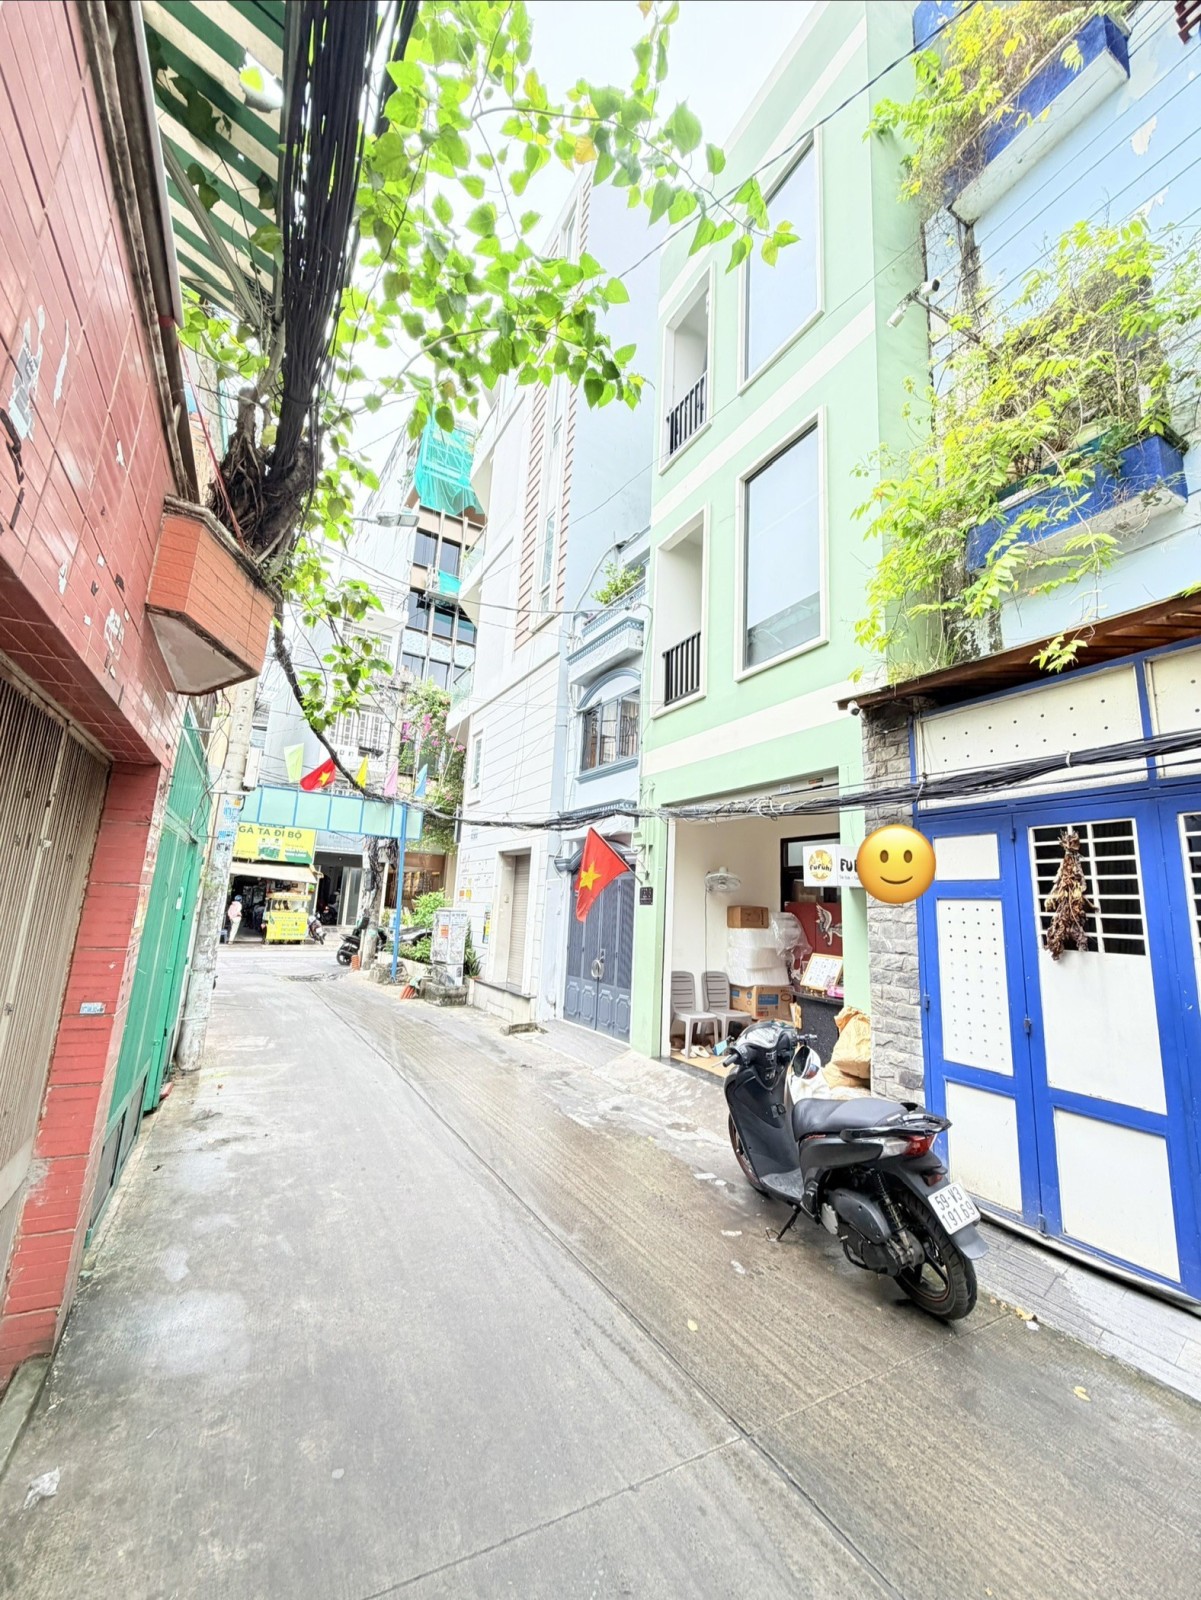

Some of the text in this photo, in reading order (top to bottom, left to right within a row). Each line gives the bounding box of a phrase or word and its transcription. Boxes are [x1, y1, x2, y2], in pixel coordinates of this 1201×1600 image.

[238, 825, 254, 834] GÀ
[257, 827, 271, 836] TA
[287, 830, 302, 841] BỘ
